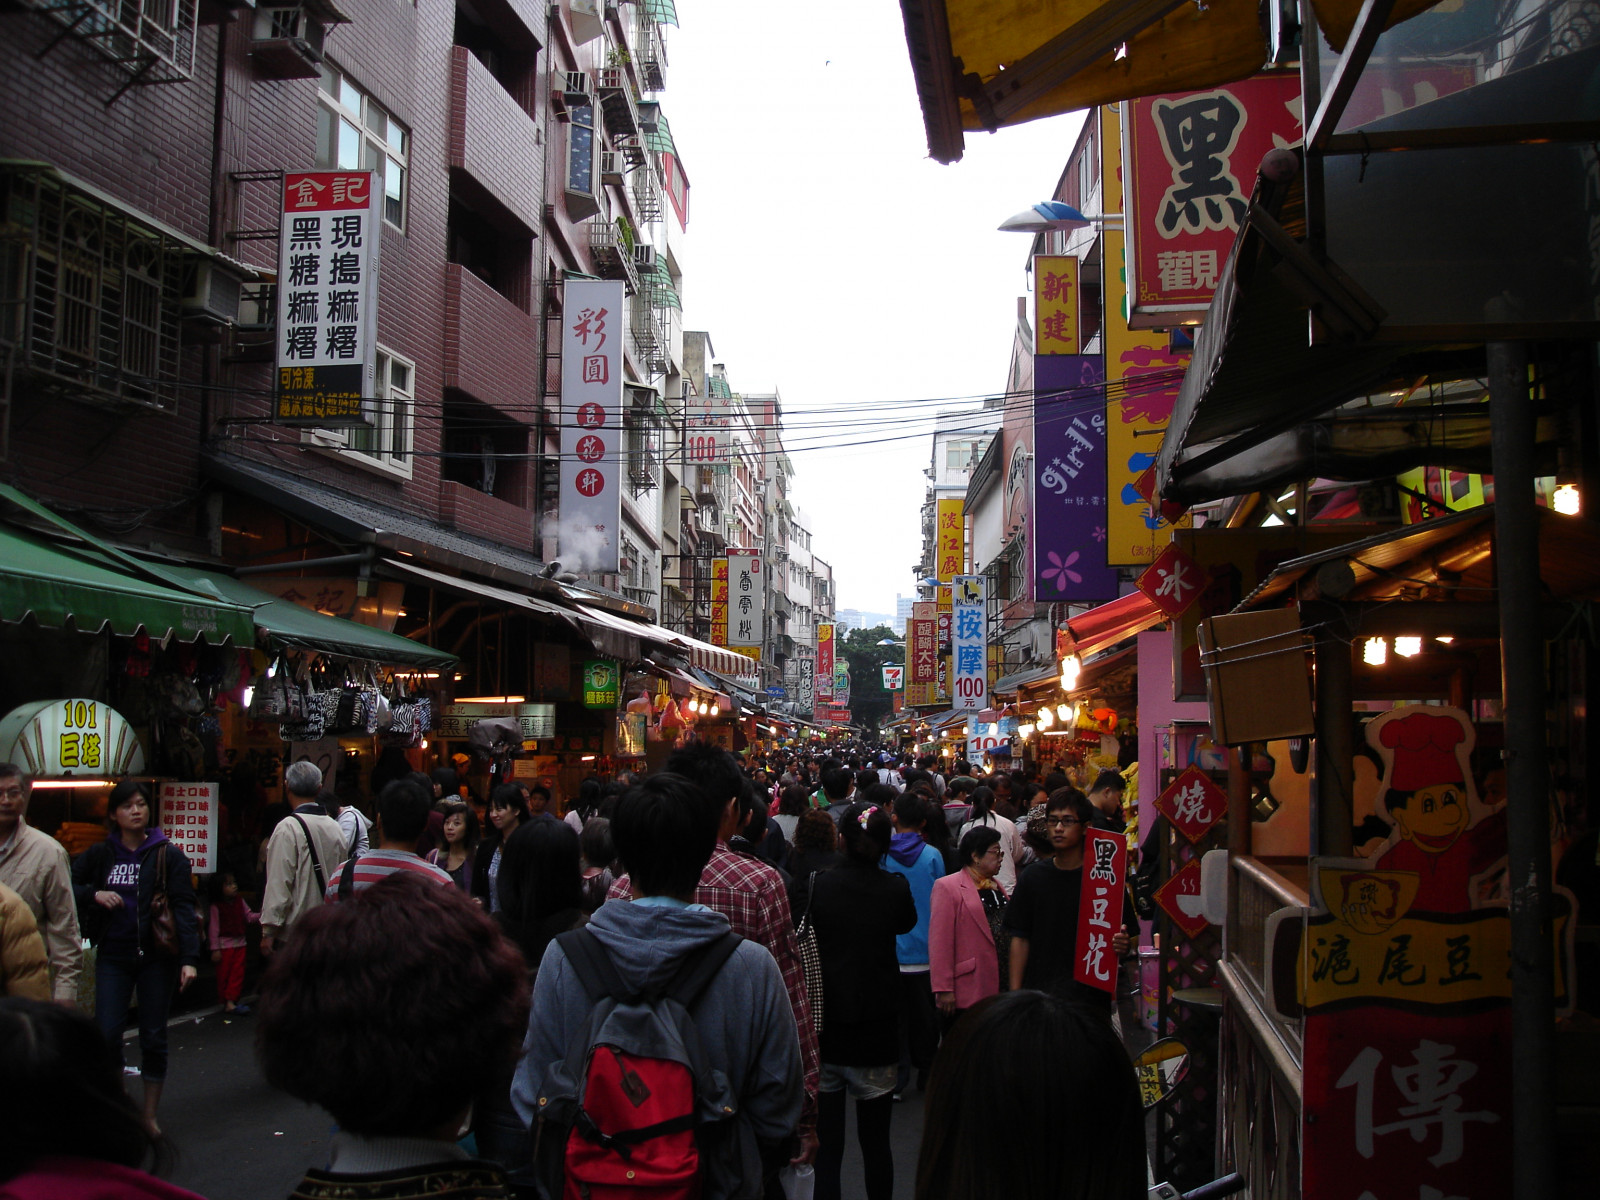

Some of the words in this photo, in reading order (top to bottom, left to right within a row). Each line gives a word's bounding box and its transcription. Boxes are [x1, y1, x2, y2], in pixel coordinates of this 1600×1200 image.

[288, 177, 369, 208] 金記
[1155, 560, 1195, 603] 冰
[917, 622, 932, 678] 醍醐大師
[957, 609, 983, 675] 按摩
[955, 677, 984, 698] 100
[964, 699, 975, 707] 元
[64, 700, 97, 728] 101
[60, 733, 101, 767] 巨塔
[1173, 780, 1212, 824] 燒
[1082, 838, 1118, 981] 黑豆花
[1312, 934, 1512, 987] 滬尾豆
[1335, 1039, 1500, 1200] 傳
